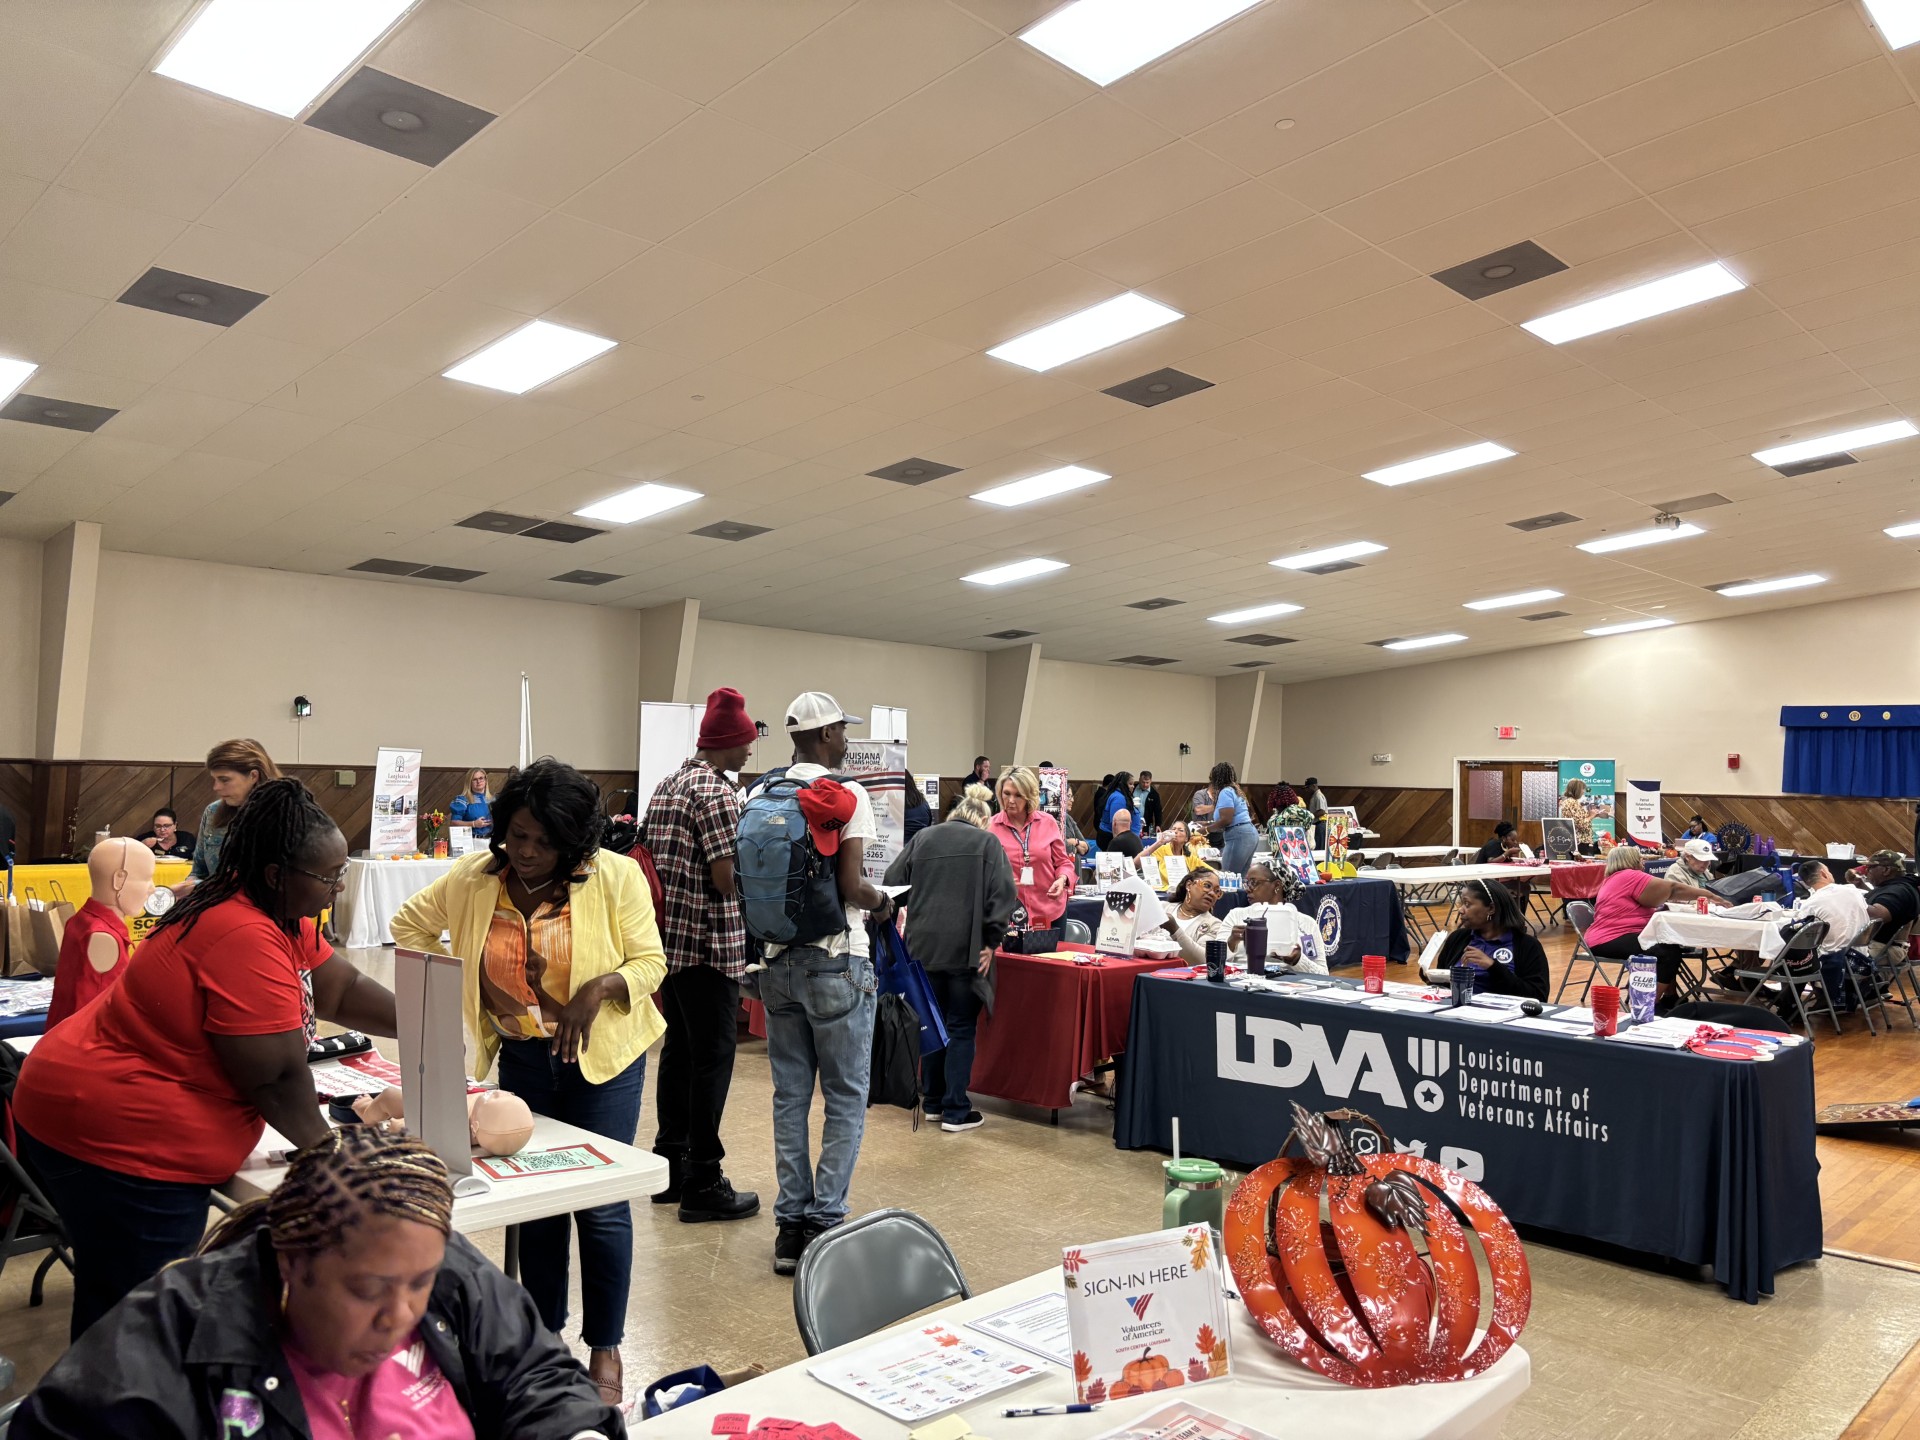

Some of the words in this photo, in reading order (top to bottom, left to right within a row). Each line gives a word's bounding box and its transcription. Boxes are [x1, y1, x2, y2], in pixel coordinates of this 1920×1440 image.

[844, 752, 880, 760] OUISIANA
[1216, 1012, 1407, 1108] LDVA
[1459, 1044, 1543, 1077] Louisiana
[1459, 1069, 1562, 1107] Department
[1571, 1087, 1589, 1112] of
[1459, 1094, 1535, 1129] Veterans
[1544, 1109, 1609, 1142] Affairs
[1084, 1272, 1145, 1297] SIGN-IN
[1150, 1264, 1188, 1284] HERE
[1121, 1320, 1162, 1334] Volunteers
[1122, 1333, 1131, 1342] of
[1115, 1346, 1130, 1354] SOUTH
[1130, 1342, 1148, 1352] CENTRAL
[1148, 1338, 1171, 1347] LOUISIANA
